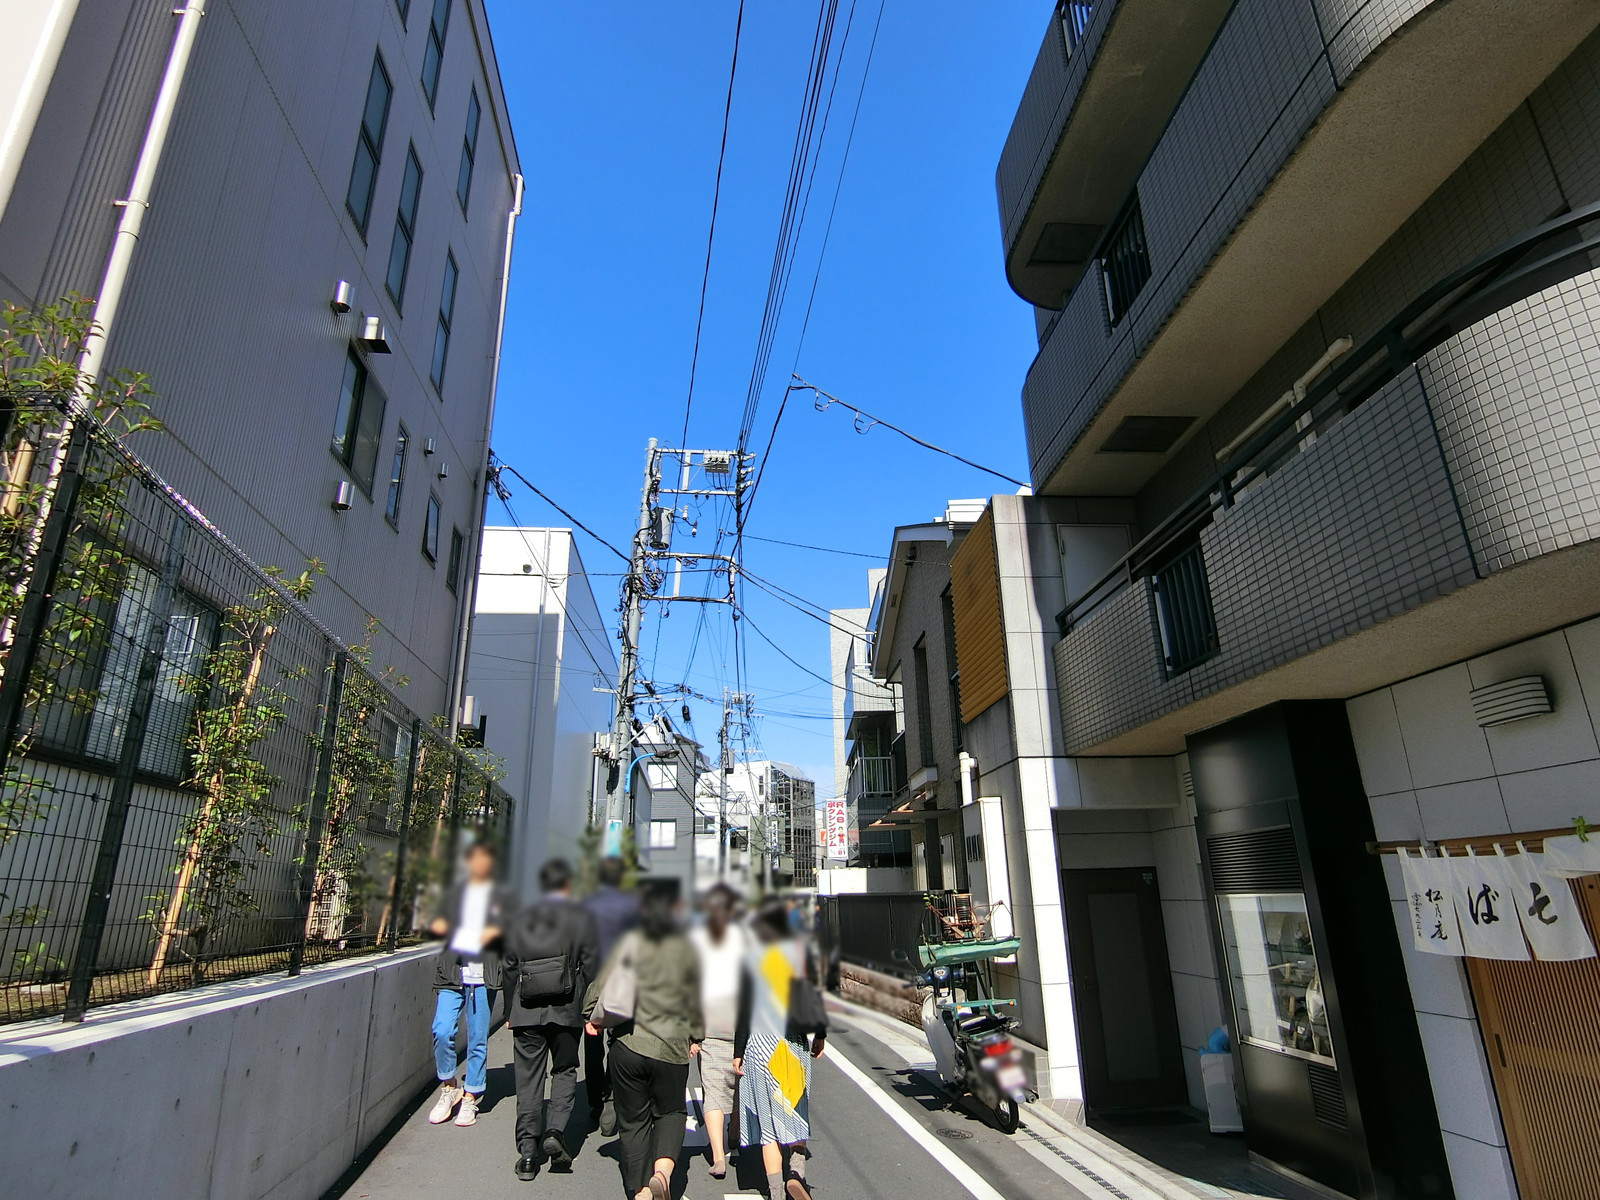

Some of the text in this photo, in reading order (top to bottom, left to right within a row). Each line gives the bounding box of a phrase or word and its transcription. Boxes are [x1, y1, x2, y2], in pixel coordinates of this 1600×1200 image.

[828, 802, 836, 846] ボクシングジム
[836, 802, 845, 823] RAB
